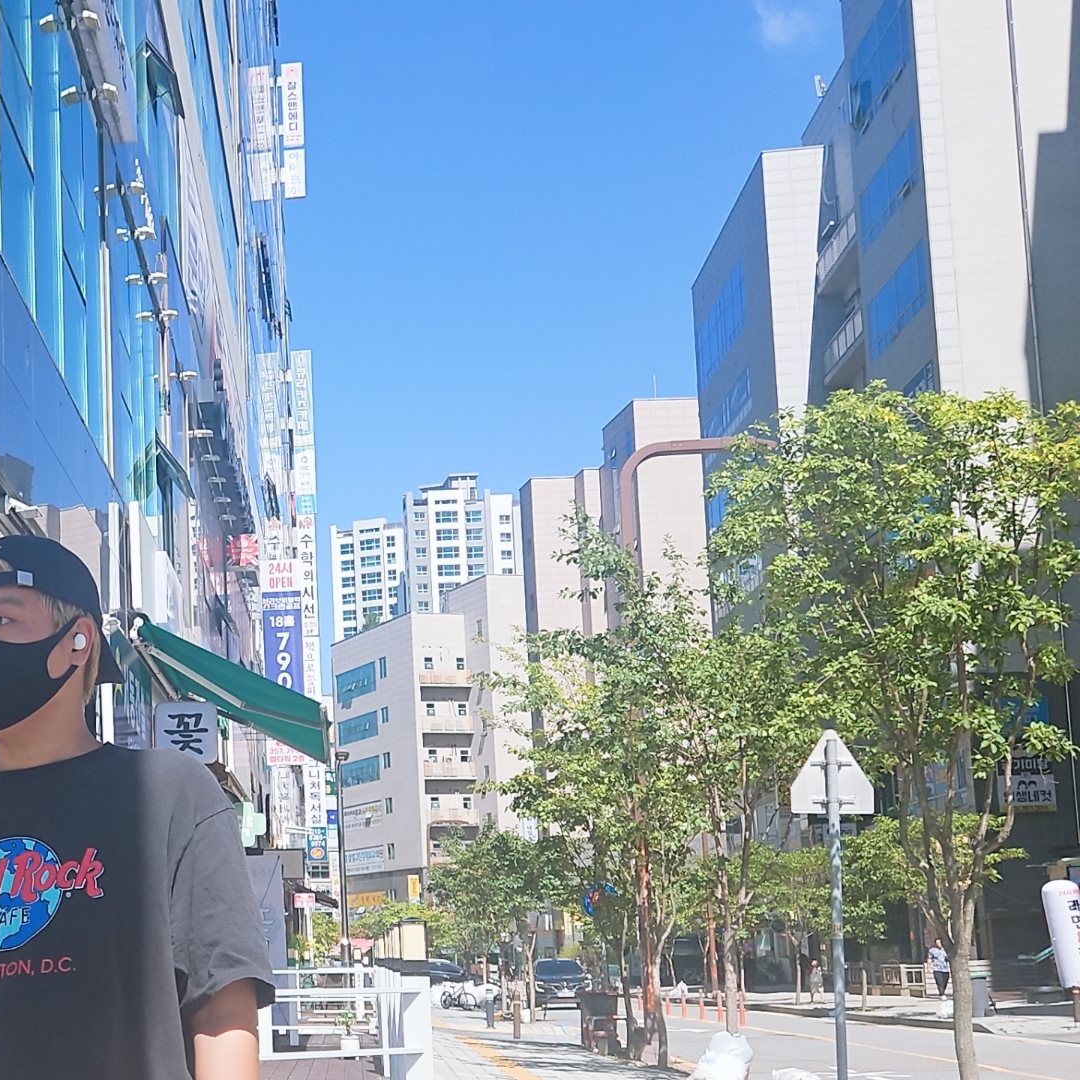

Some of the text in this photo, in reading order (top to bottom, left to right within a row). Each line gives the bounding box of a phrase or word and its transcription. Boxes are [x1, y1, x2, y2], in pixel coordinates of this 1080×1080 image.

[268, 562, 293, 574] 24시
[269, 577, 293, 588] OPEN
[300, 534, 316, 619] 수학의시선
[163, 713, 209, 755] 꽃
[10, 848, 105, 904] Rock
[40, 956, 77, 974] D.C.
